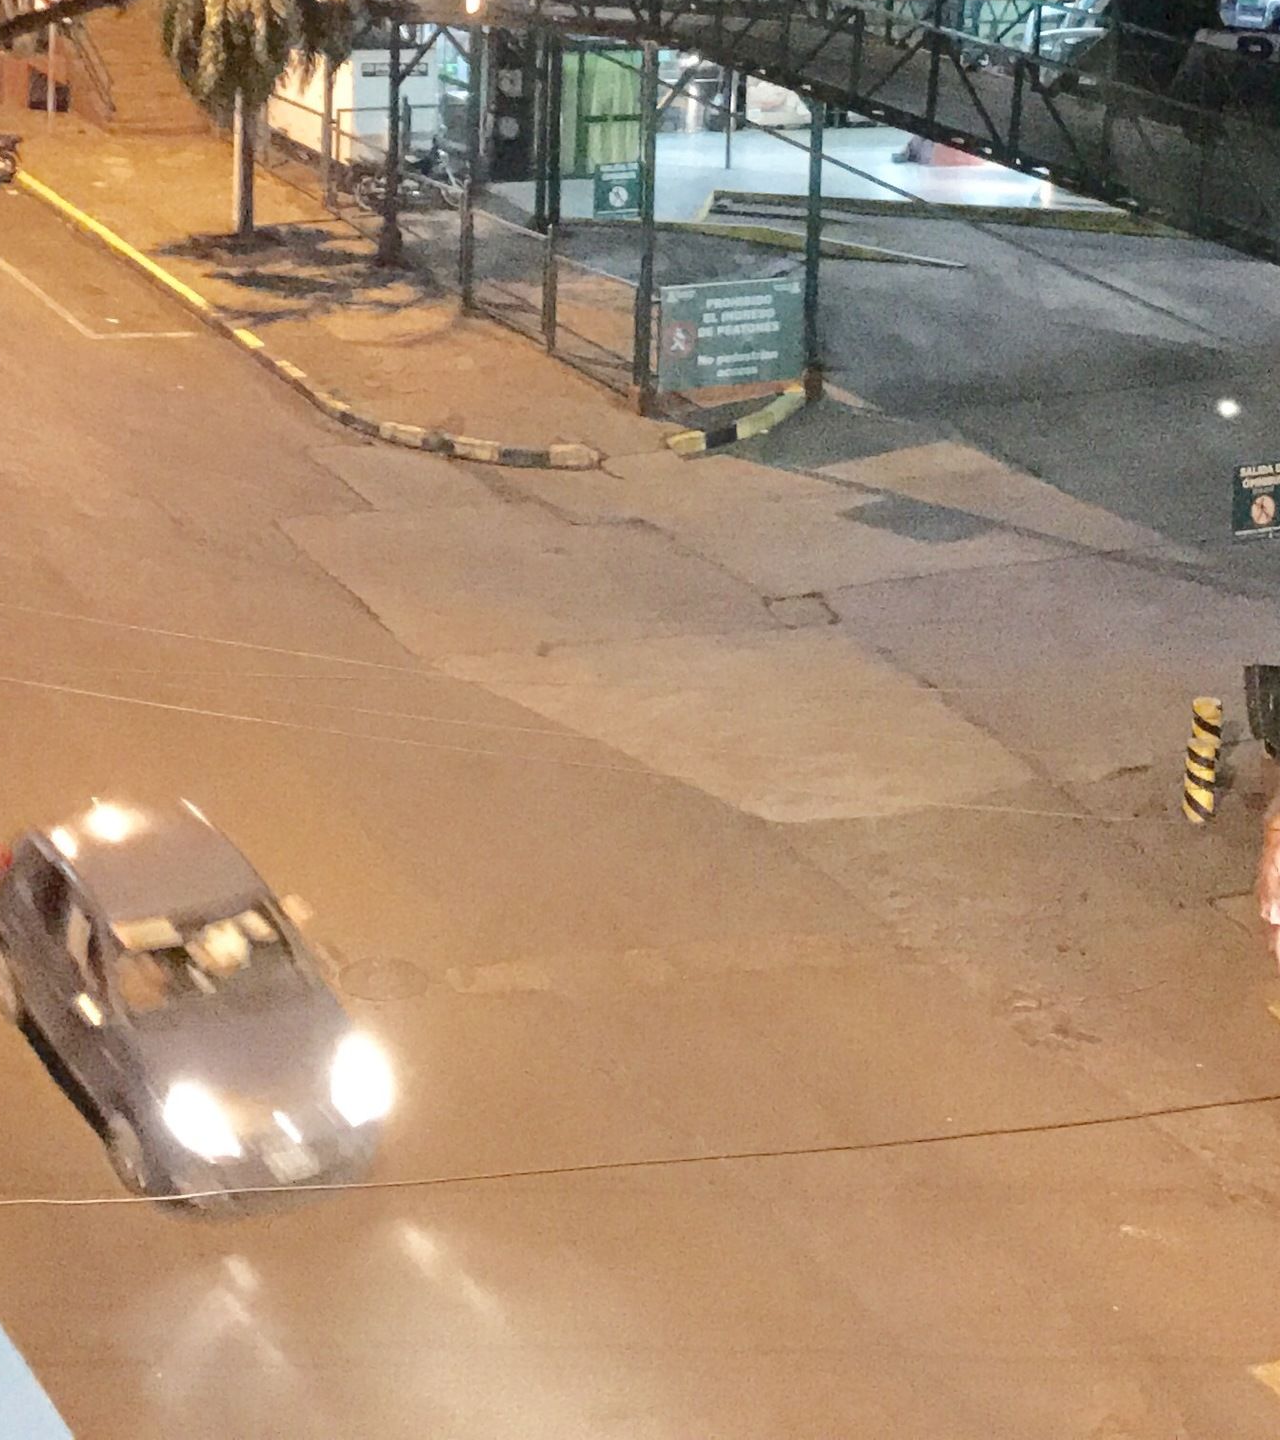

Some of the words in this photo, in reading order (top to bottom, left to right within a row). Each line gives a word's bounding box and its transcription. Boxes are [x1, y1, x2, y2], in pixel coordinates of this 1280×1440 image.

[702, 312, 718, 323] EL
[697, 326, 714, 338] DE
[717, 321, 780, 336] PEATONES
[1240, 464, 1274, 478] SALIDA
